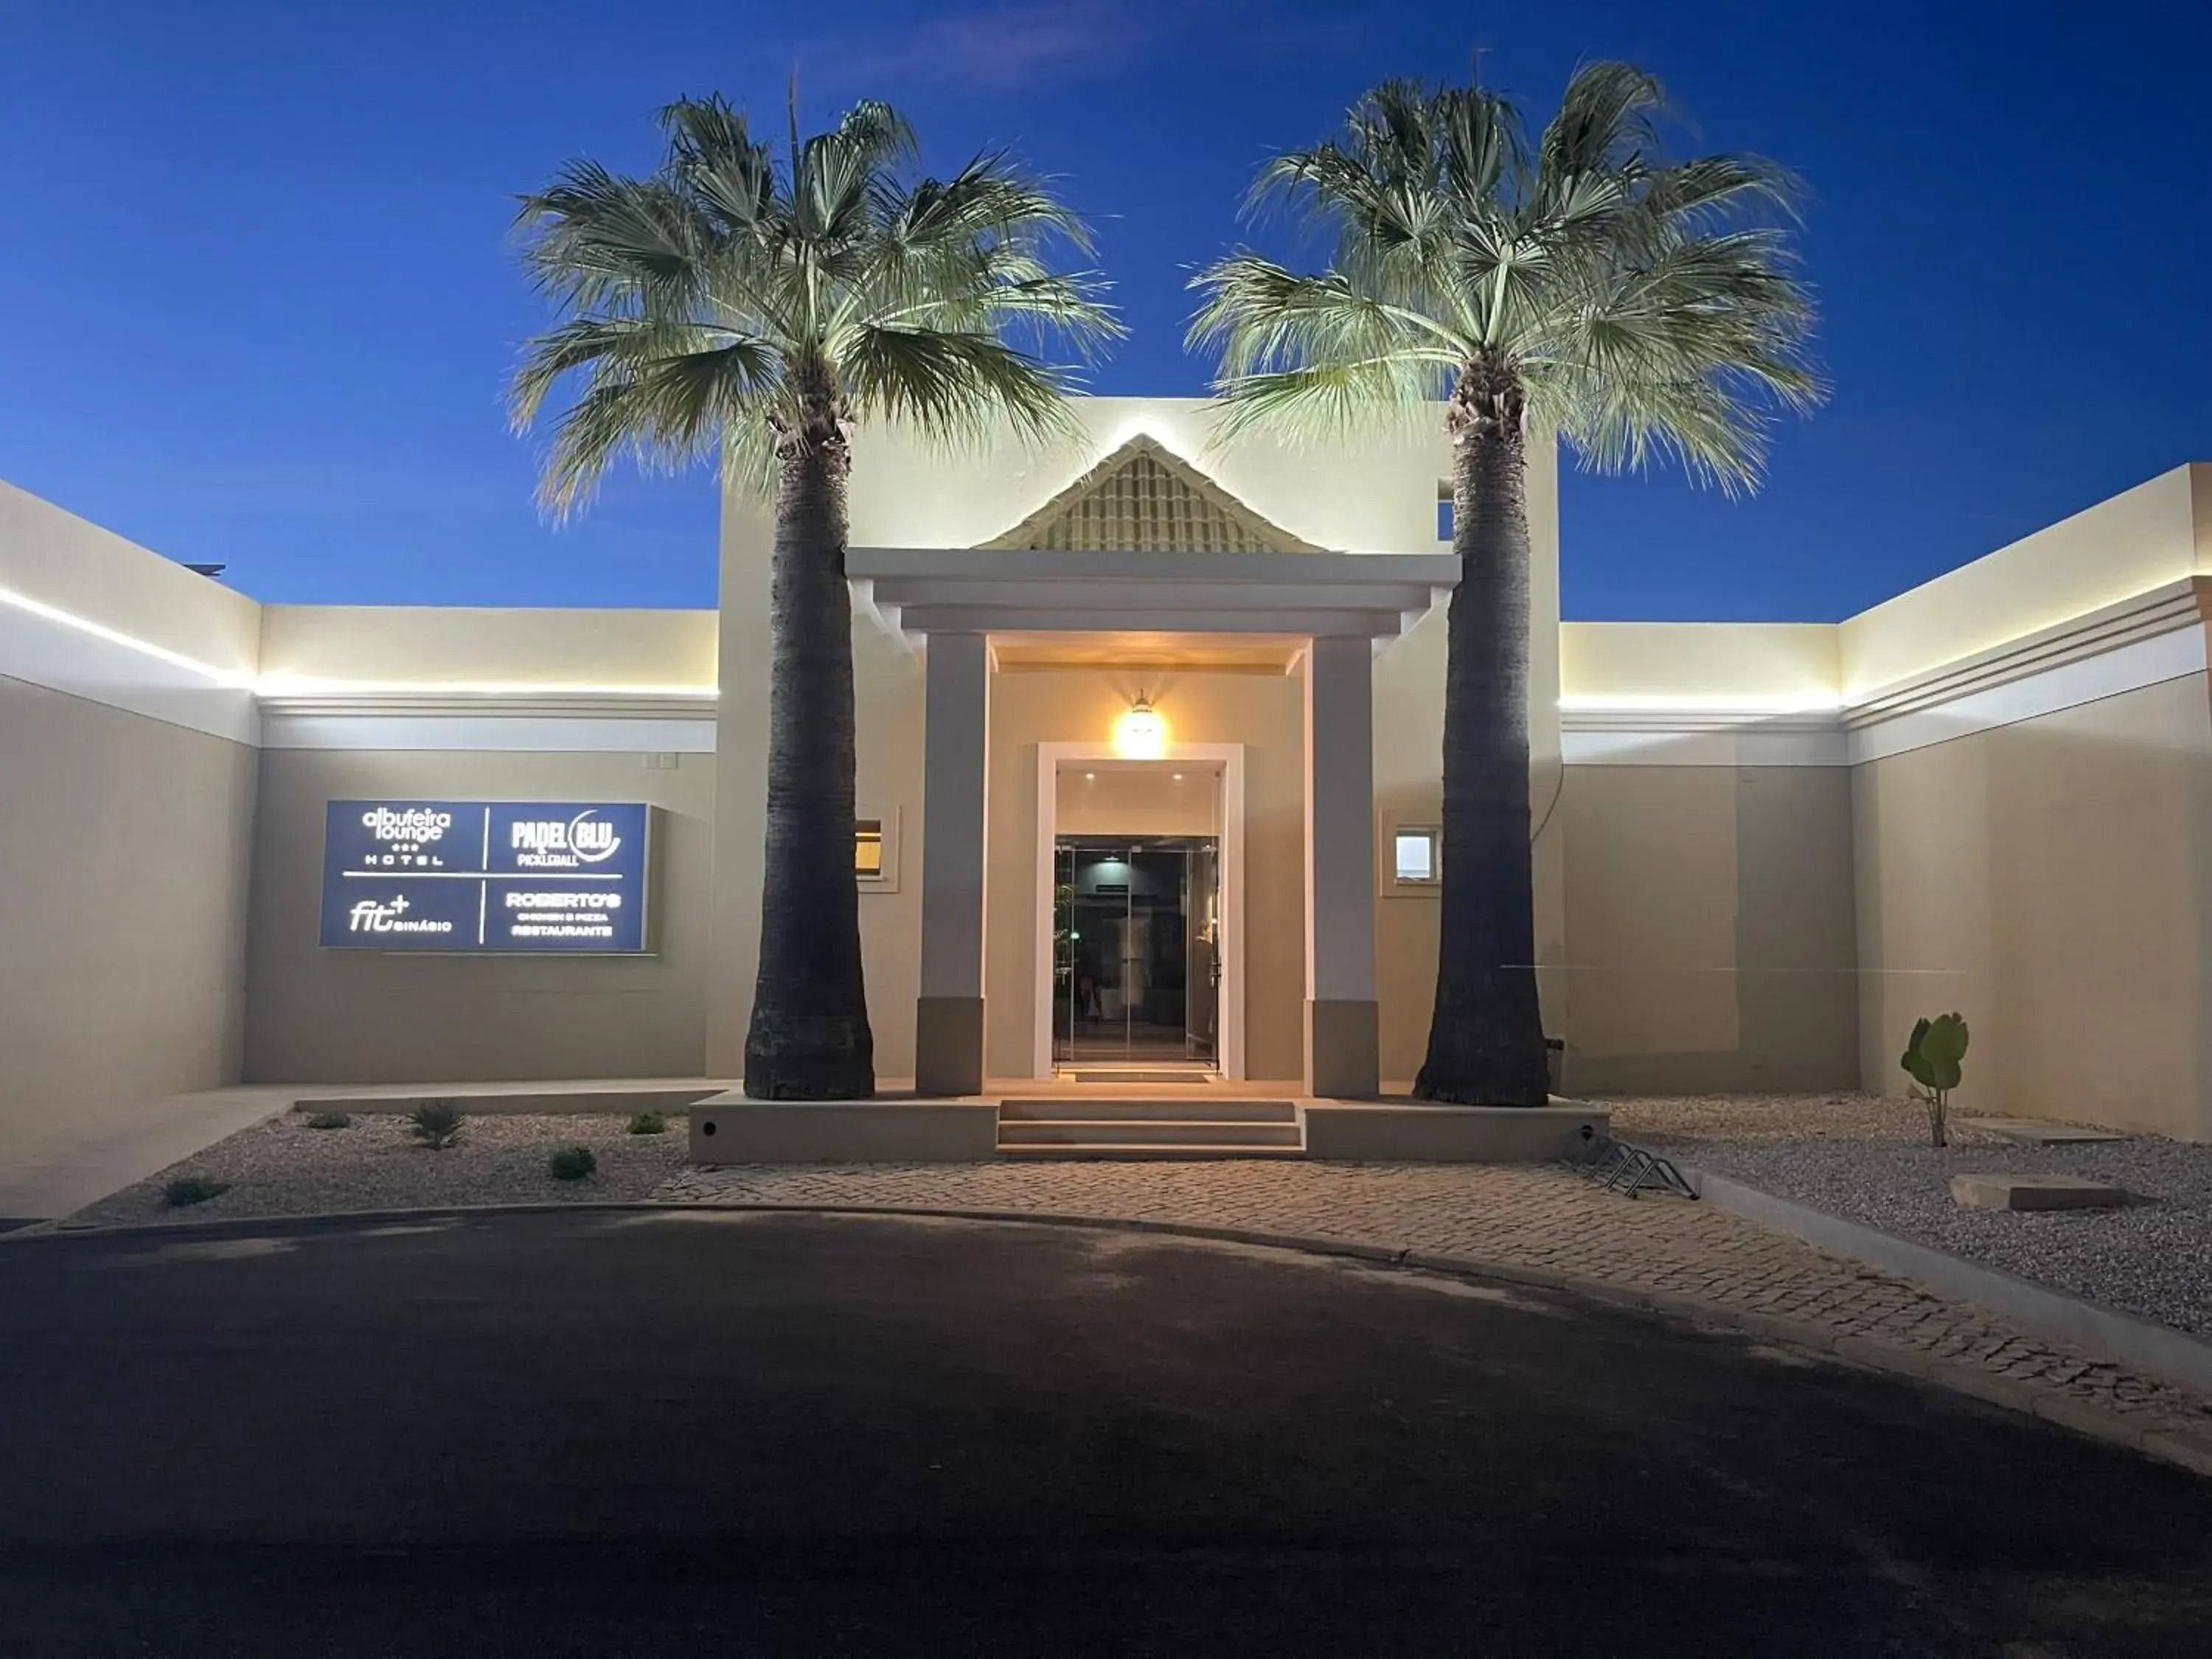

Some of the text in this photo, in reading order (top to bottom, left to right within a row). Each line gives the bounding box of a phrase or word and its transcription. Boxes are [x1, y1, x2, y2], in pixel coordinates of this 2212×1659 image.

[362, 807, 451, 827] albufeira
[375, 825, 443, 843] lounge
[512, 822, 613, 849] PADEL BLU
[365, 855, 444, 866] HOTEL
[518, 854, 580, 866] PICKLEBALL
[506, 892, 622, 908] ROBERTO'S
[511, 925, 613, 937] RESTAURANTE
